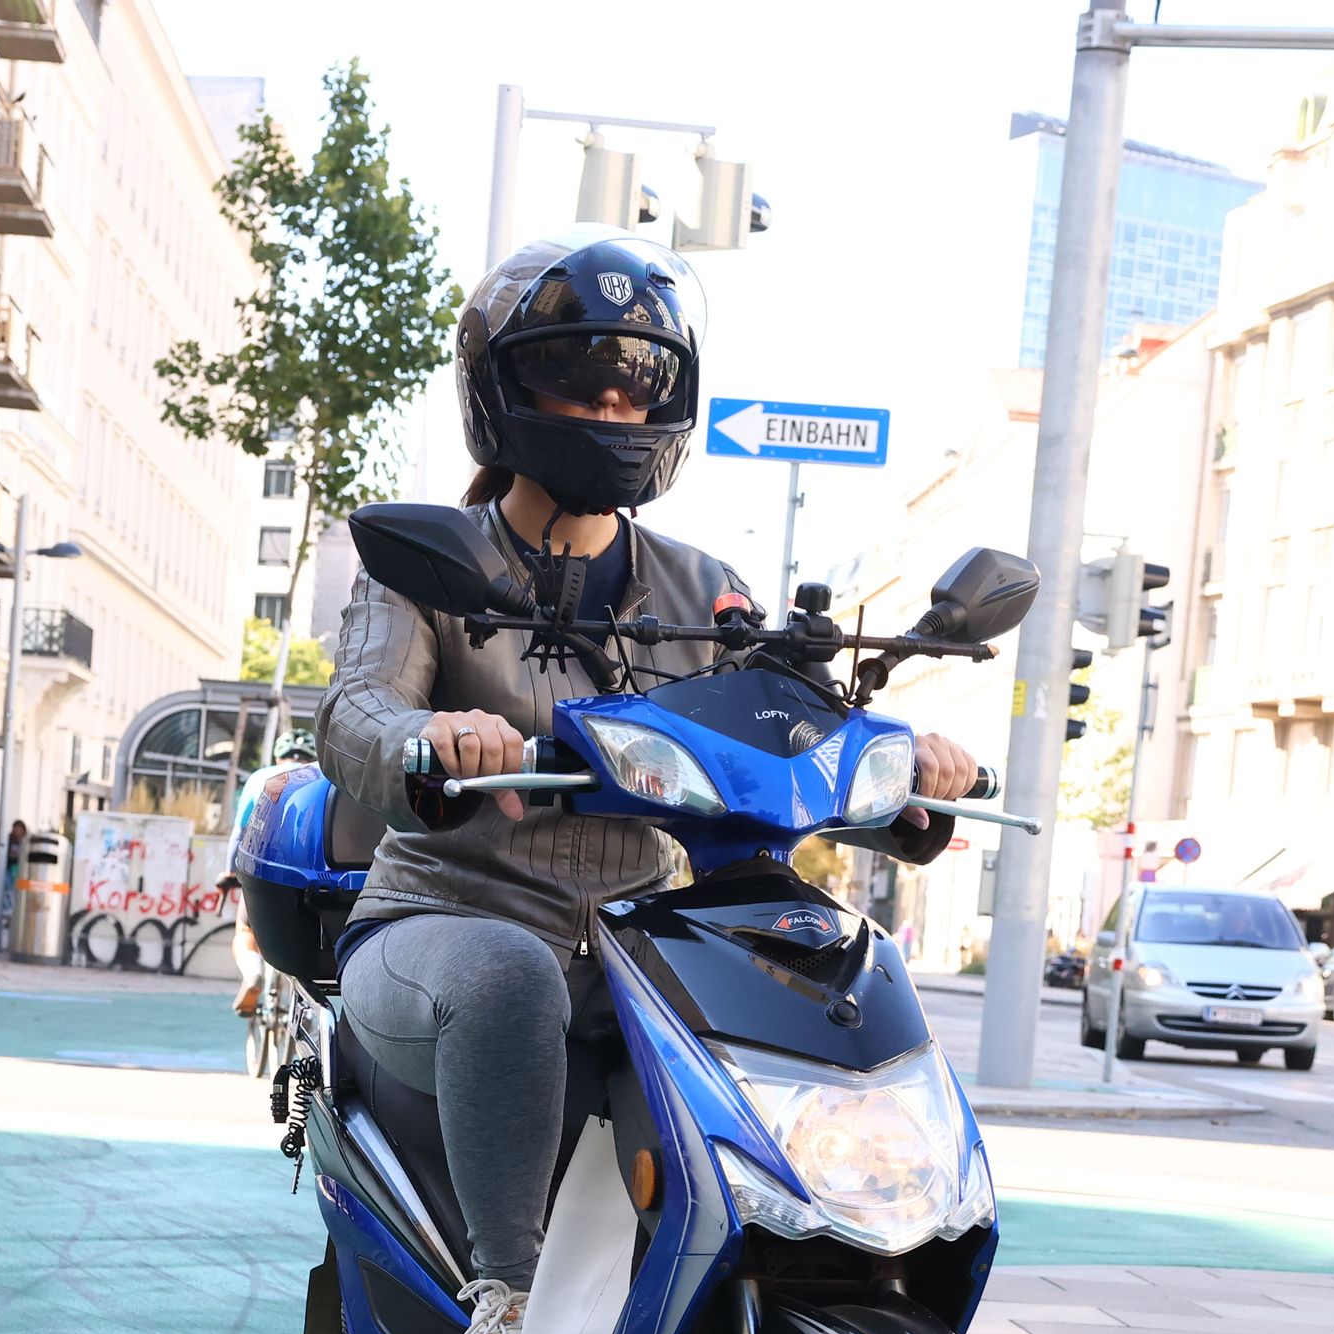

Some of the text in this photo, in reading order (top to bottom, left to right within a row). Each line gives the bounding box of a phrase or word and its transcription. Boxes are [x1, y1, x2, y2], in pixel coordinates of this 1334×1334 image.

[766, 418, 868, 447] EINBAHN
[754, 710, 789, 721] LOFTY
[788, 915, 822, 926] FALCON
